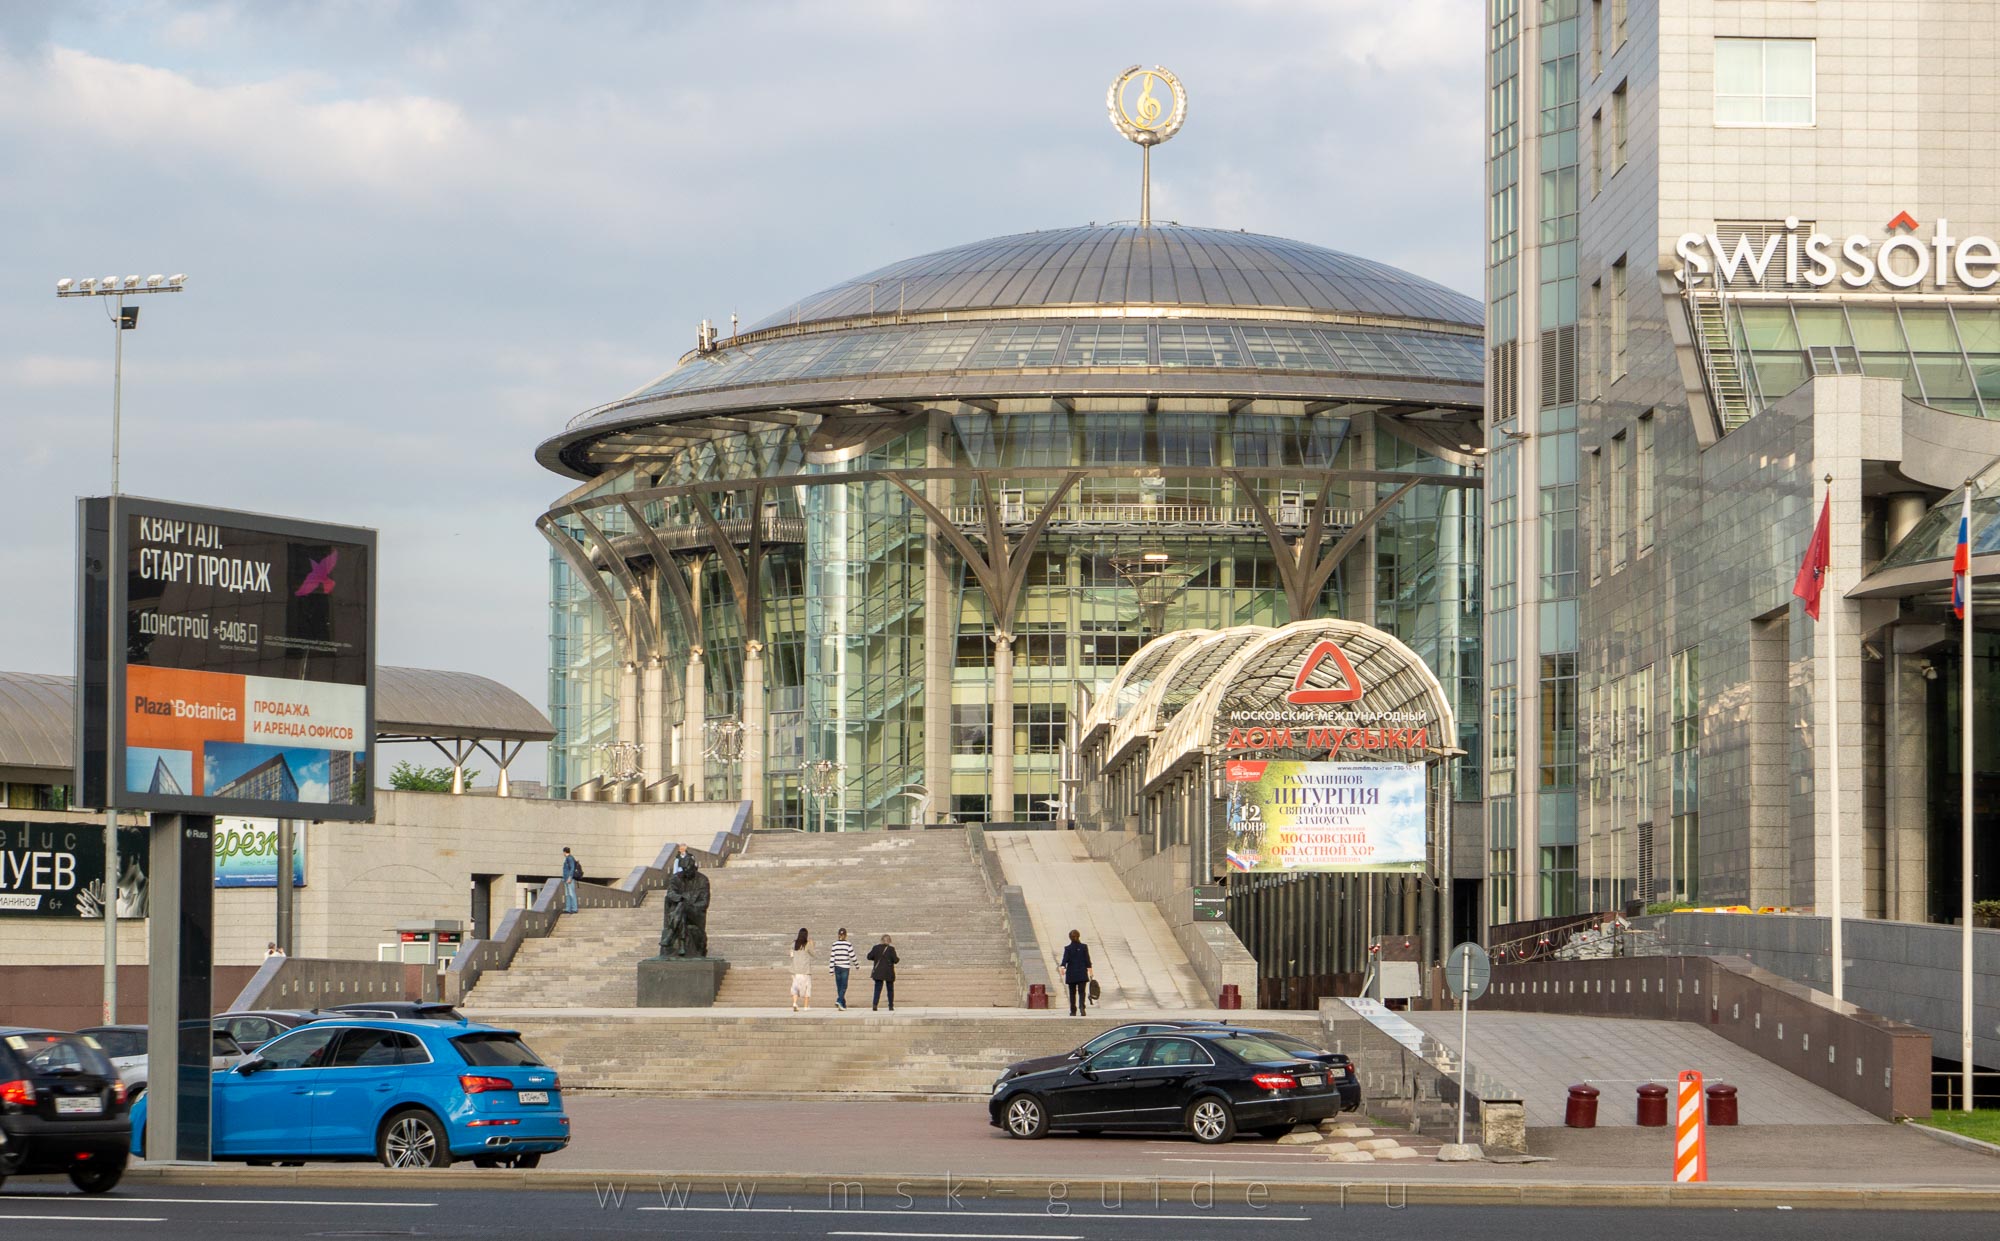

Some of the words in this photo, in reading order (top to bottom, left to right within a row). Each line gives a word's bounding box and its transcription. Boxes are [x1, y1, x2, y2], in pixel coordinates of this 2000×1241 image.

[140, 548, 194, 583] СТАРТ
[198, 554, 271, 593] ПРОДАЖ
[139, 612, 209, 640] ДОНСТРОЙ
[134, 695, 171, 716] Plaza
[174, 699, 237, 721] Botanica
[253, 700, 310, 717] ПРОДАЖА
[1230, 709, 1314, 722] МОСКОВСКИЙ
[1317, 710, 1427, 723] МЕЖДУНАРОДНЫЙ
[253, 721, 262, 733] И
[263, 721, 306, 738] АРЕНДА
[308, 724, 354, 740] ОФИСОВ
[1225, 726, 1293, 750] ДОМ
[1305, 726, 1428, 760] МУЗЫКИ
[1283, 775, 1363, 786] РАХМАНИНОВ
[1265, 787, 1379, 806] ЛИТУРГИЯ
[1240, 804, 1261, 822] 12
[1233, 822, 1266, 832] ИЮНЯ
[215, 818, 297, 866] ерёзк
[1279, 832, 1366, 844] МОСКОВСКИЙ
[1271, 844, 1346, 856] ОБЛАСТНОЙ
[1351, 846, 1375, 856] ХОР
[49, 898, 62, 909] 6+
